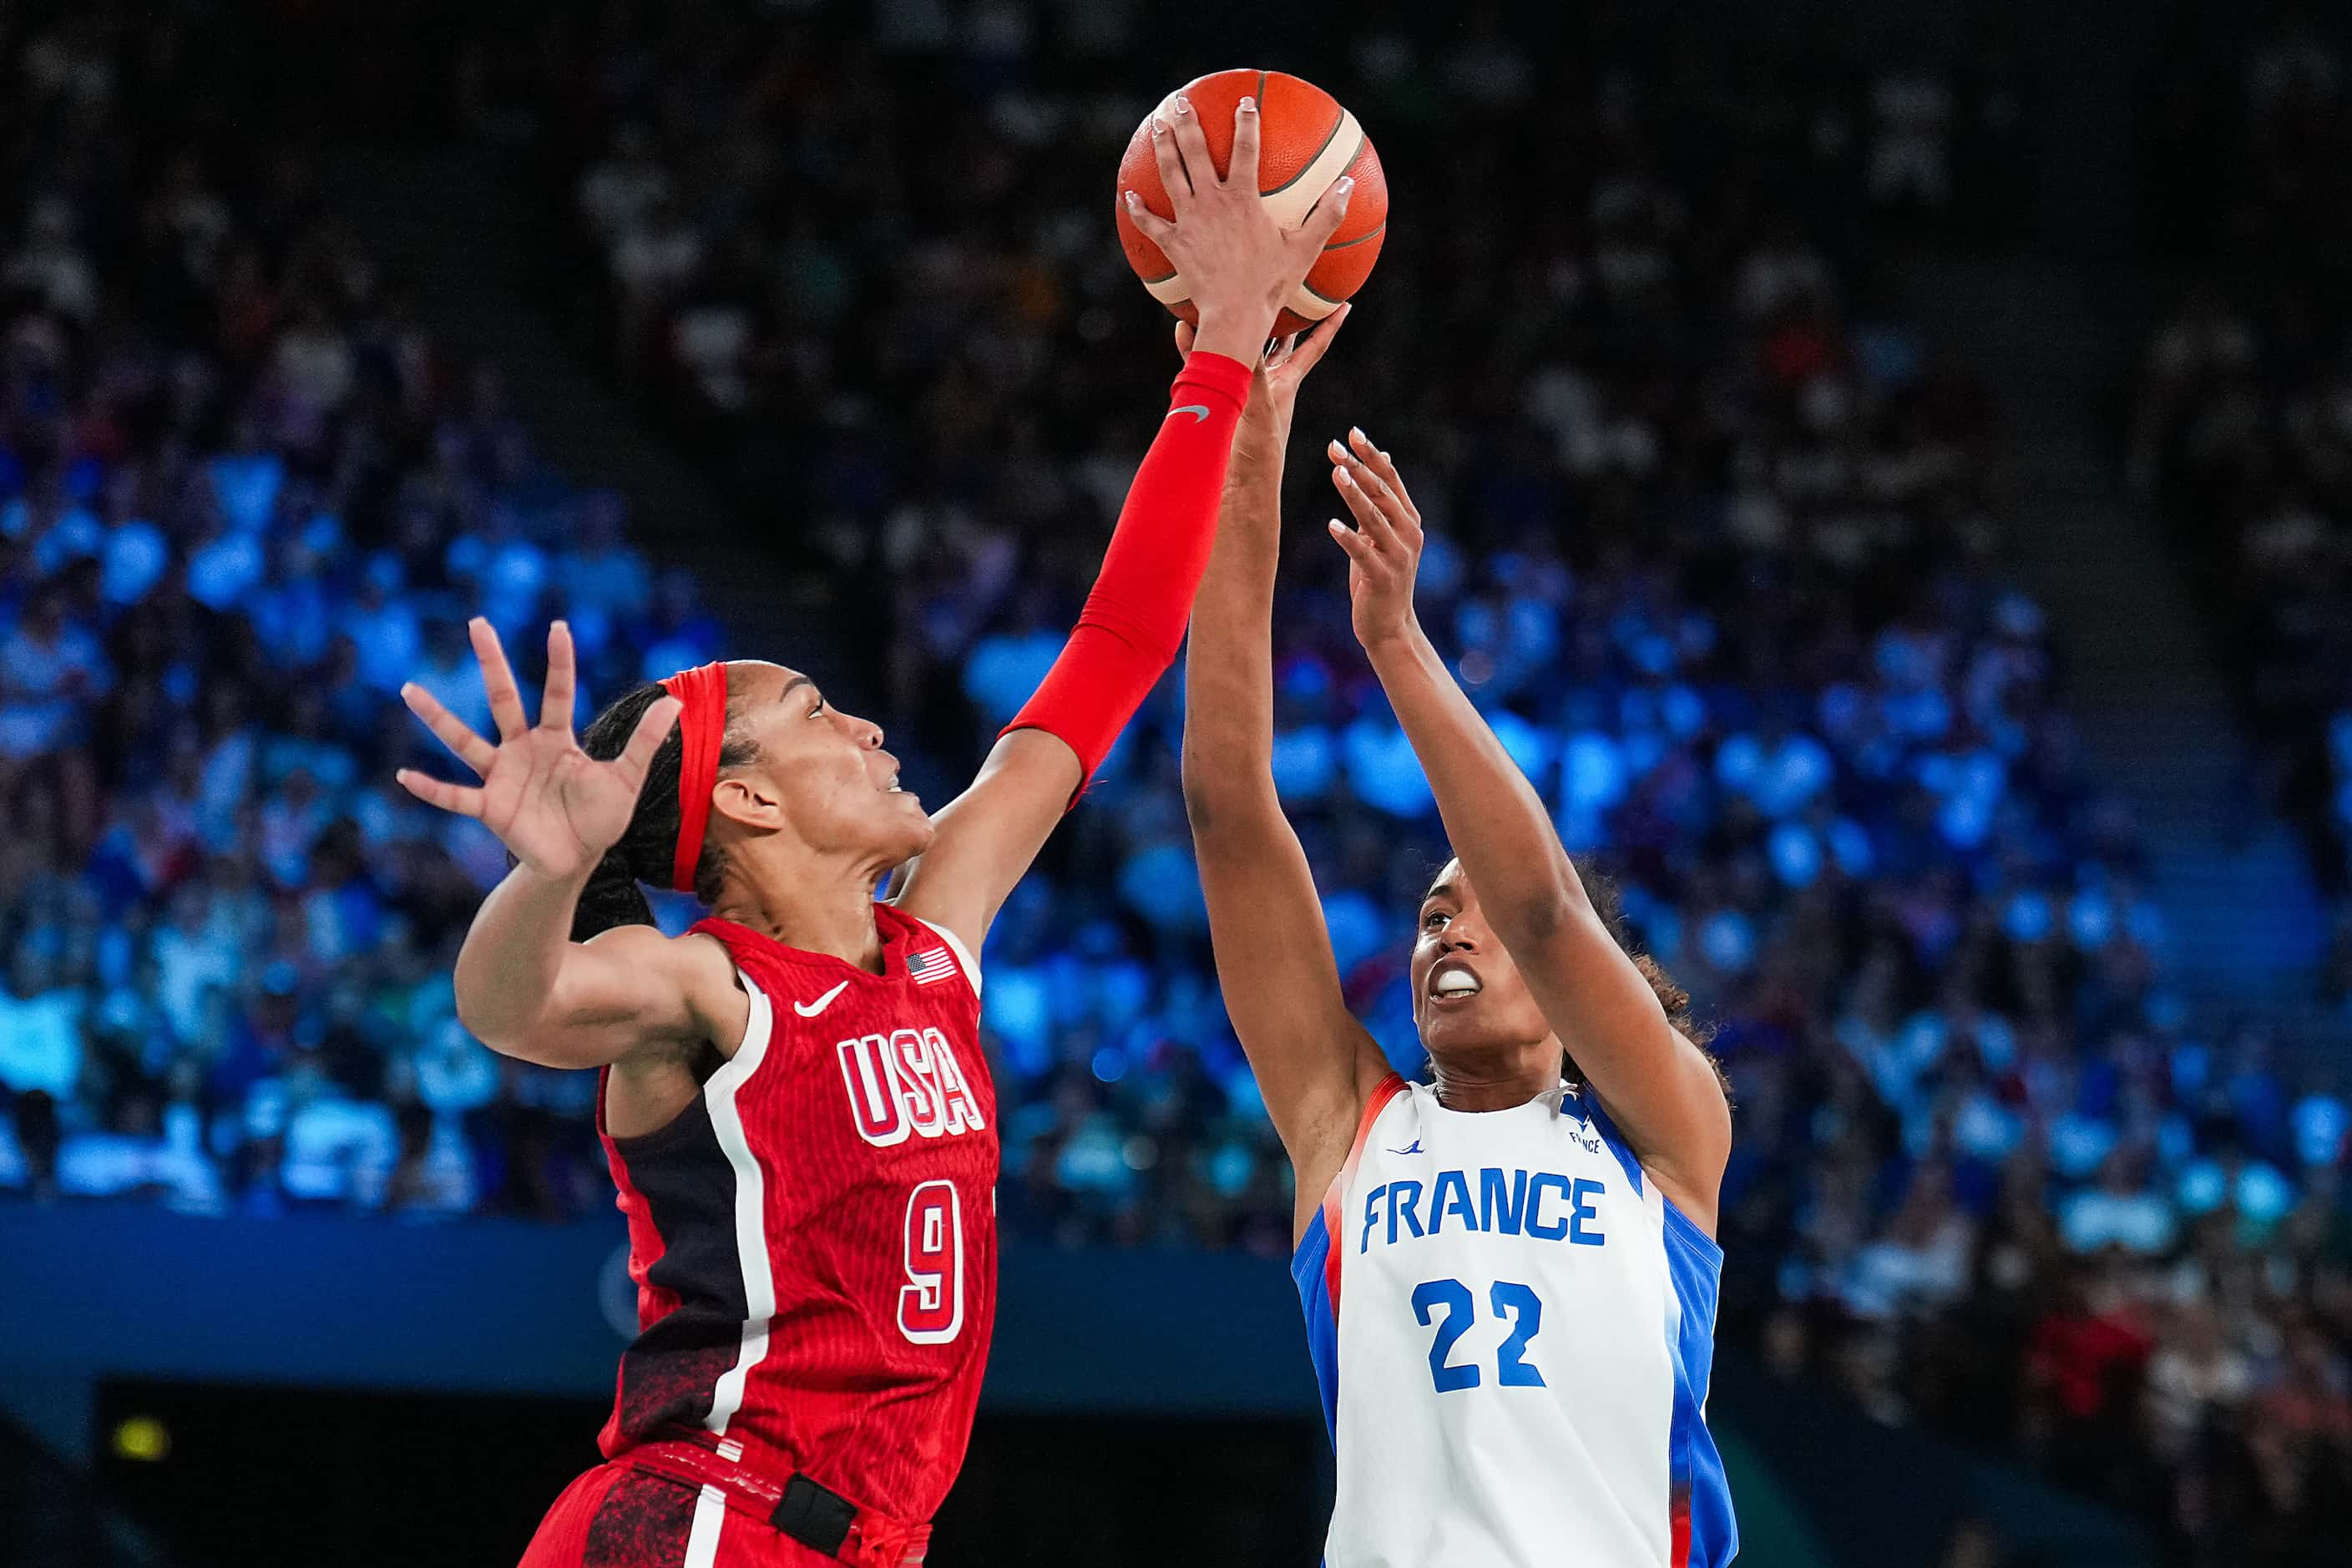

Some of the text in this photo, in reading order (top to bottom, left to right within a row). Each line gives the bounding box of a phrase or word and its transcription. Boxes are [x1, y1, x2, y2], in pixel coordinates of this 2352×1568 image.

[837, 1028, 985, 1146] USA
[898, 1181, 964, 1344] 9
[1361, 1168, 1605, 1254] FRANCE
[1411, 1279, 1546, 1393] 22
